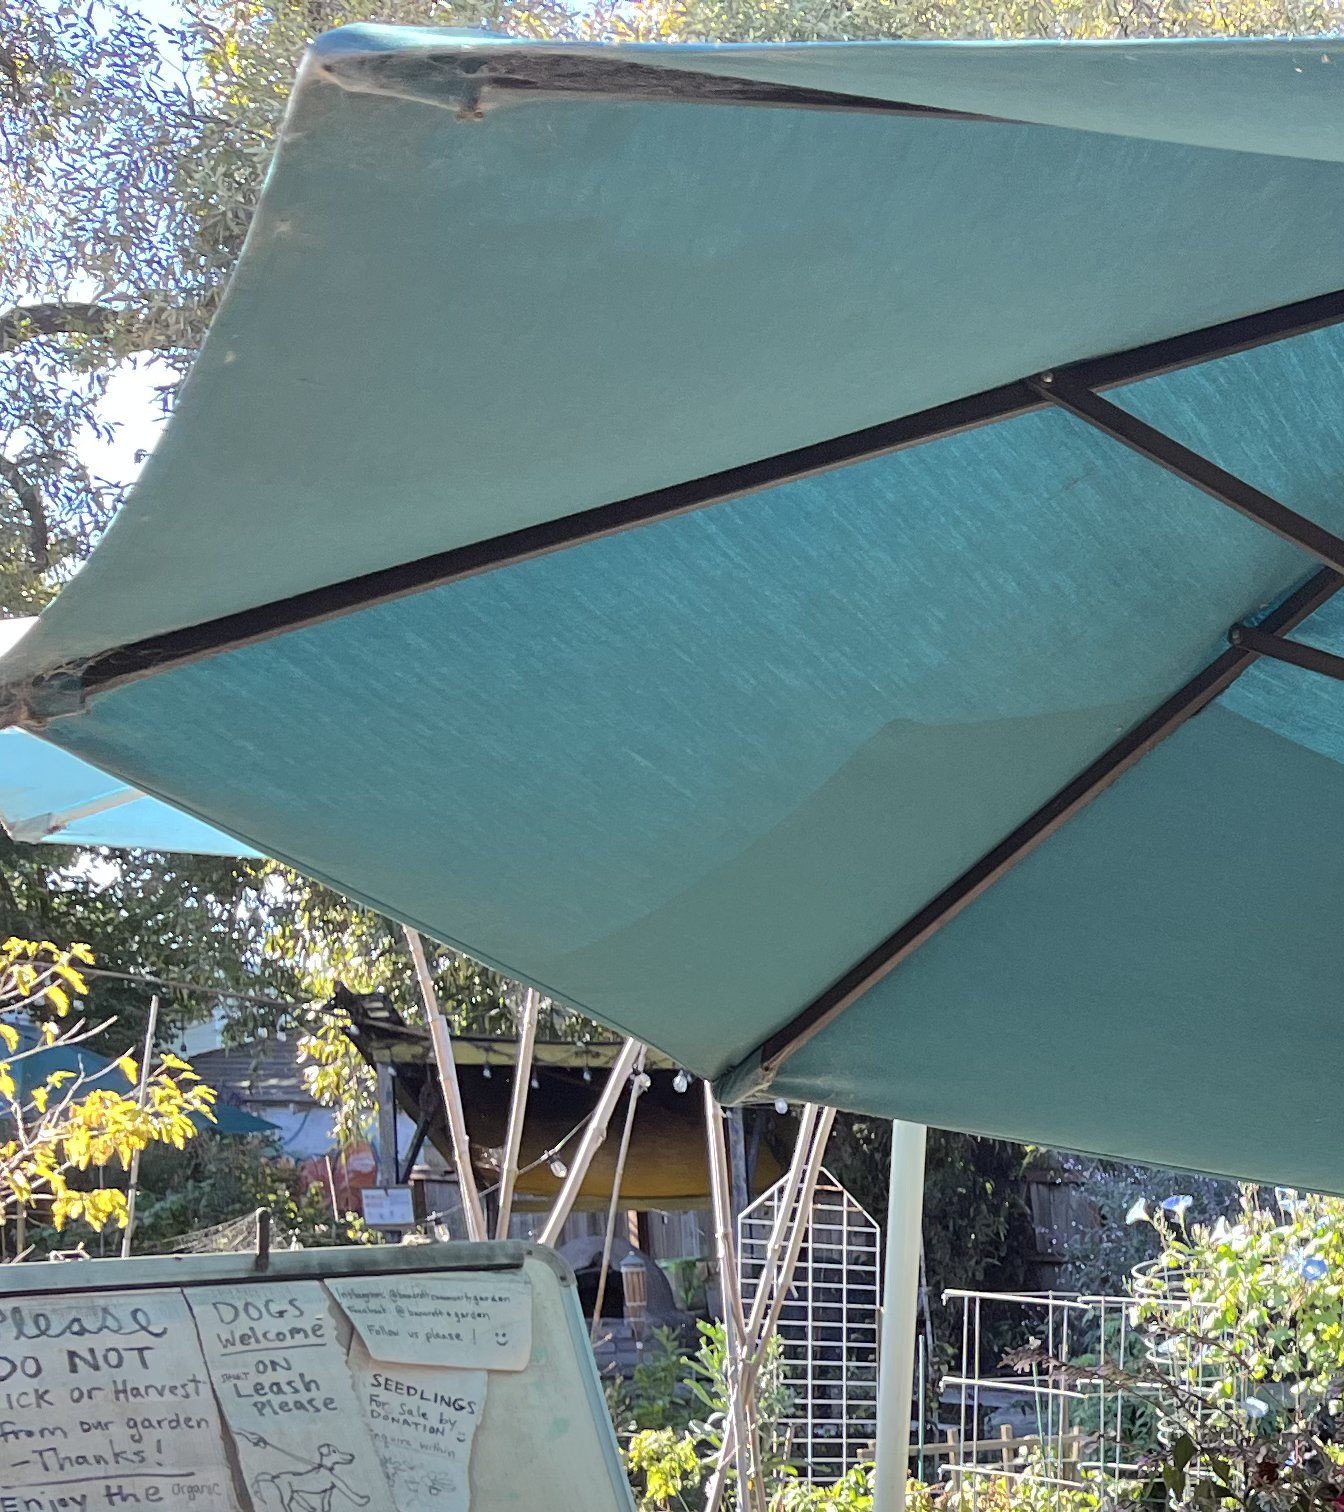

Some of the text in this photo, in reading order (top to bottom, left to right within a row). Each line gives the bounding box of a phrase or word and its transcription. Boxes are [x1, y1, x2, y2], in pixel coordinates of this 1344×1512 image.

[211, 1297, 305, 1326] DOGS
[215, 1323, 326, 1350] Welcome
[366, 1324, 399, 1337] Follow
[407, 1330, 419, 1339] us
[66, 1346, 155, 1374] NOT
[253, 1356, 293, 1376] ON
[5, 1373, 207, 1410] ICK or Harvest
[232, 1371, 321, 1399] Leash
[370, 1373, 477, 1416] SEEDLINGS
[369, 1393, 458, 1432] For Sale by
[370, 1408, 446, 1437] DONATION
[0, 1412, 210, 1444] from our garden
[104, 1484, 164, 1506] the
